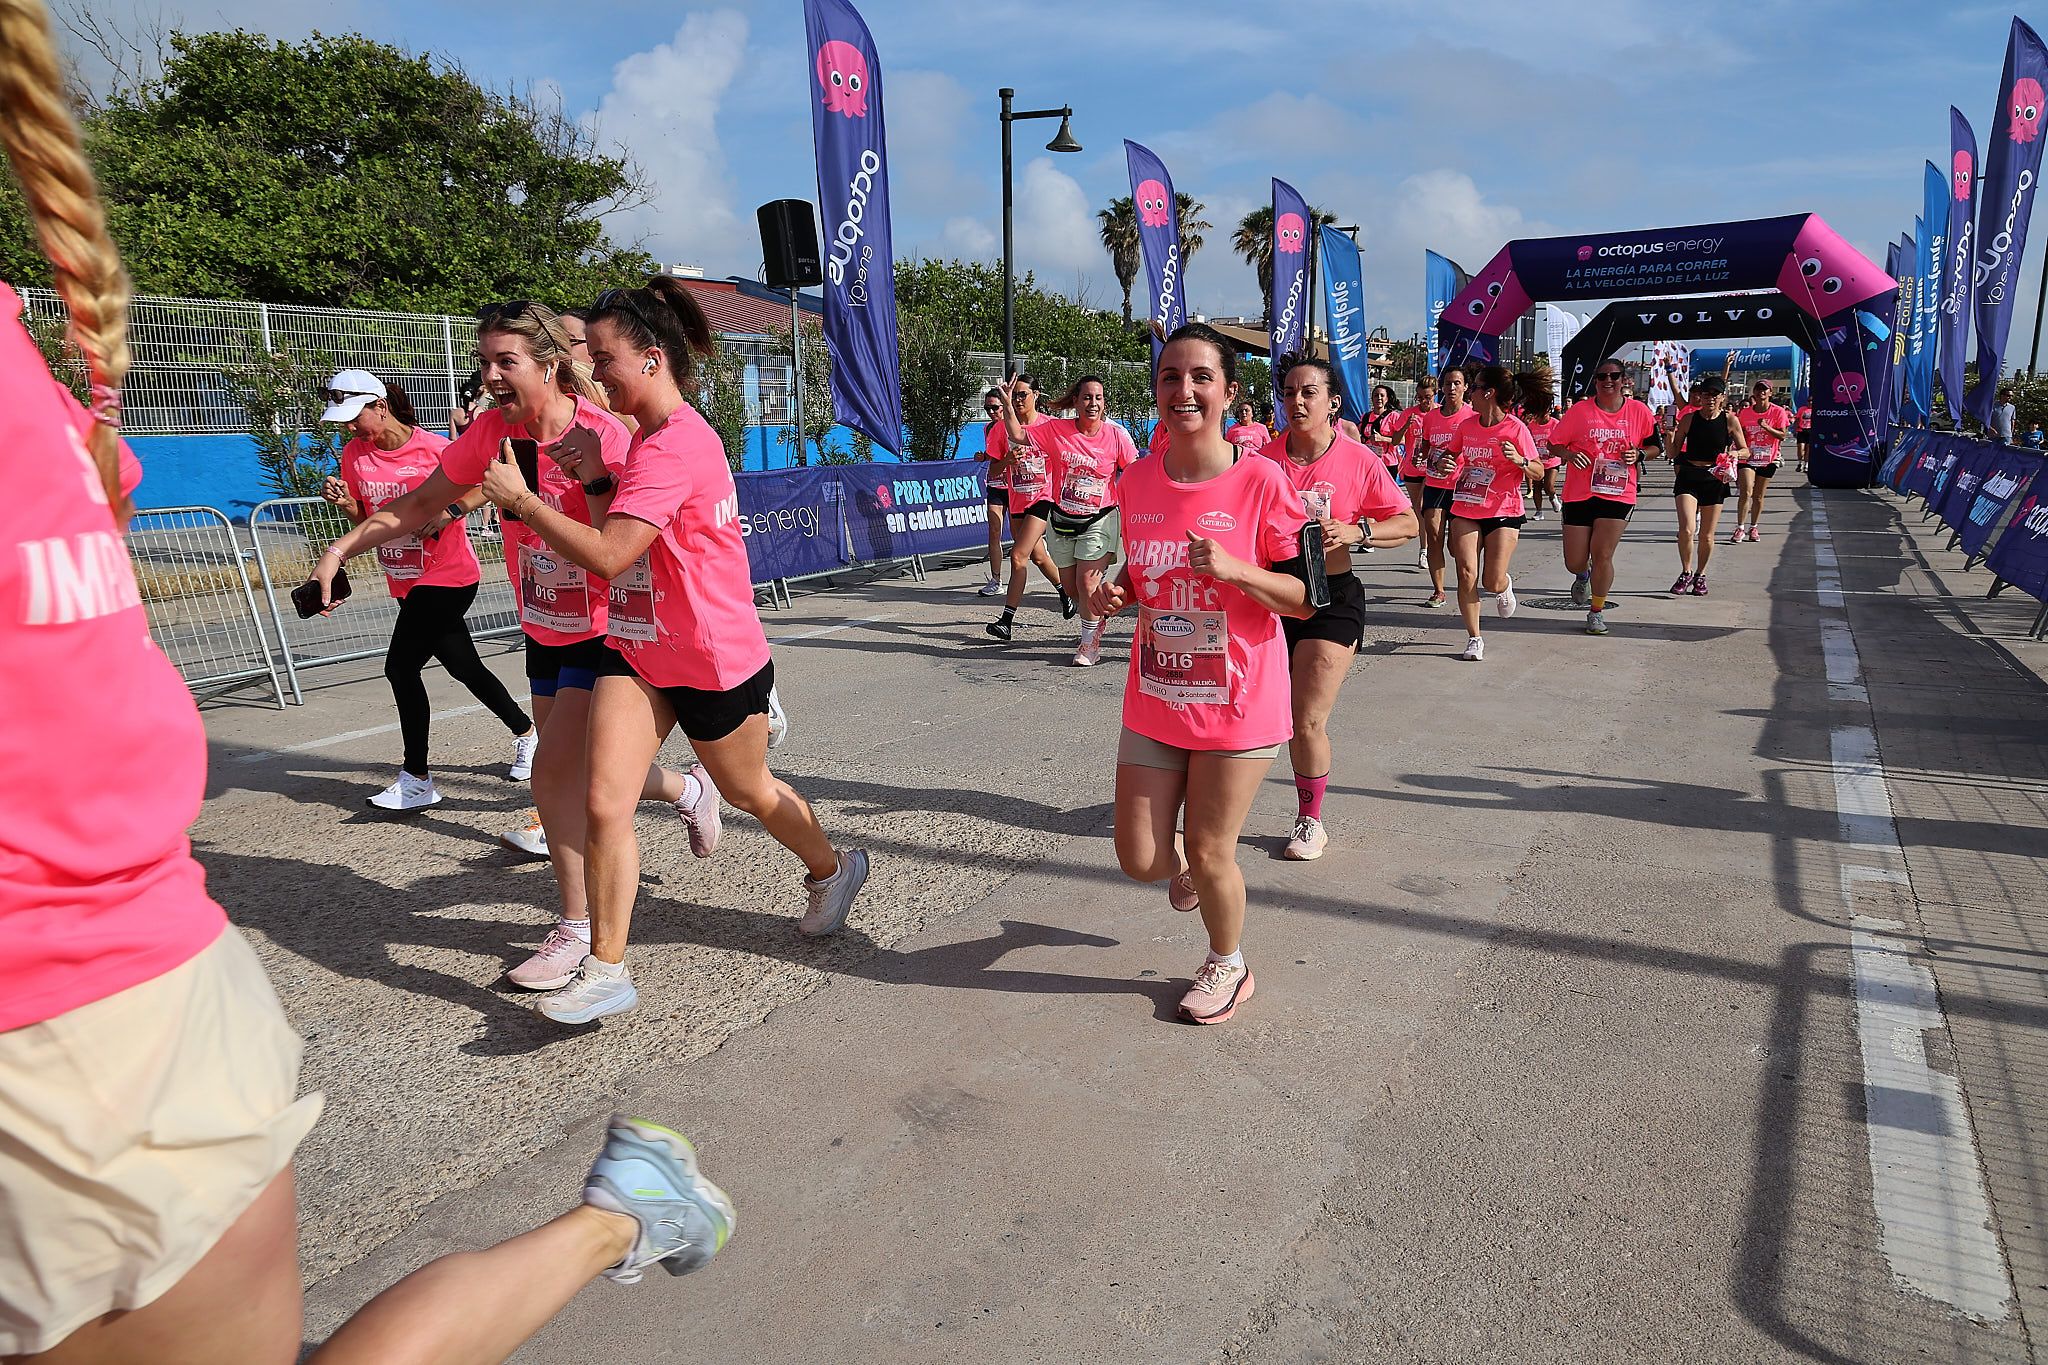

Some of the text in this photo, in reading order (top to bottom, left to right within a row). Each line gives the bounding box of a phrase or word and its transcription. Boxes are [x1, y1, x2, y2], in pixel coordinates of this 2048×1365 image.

[1598, 237, 1724, 258] octopus energy
[1566, 259, 1728, 278] LA ENERGÍA PARA CORRER
[1565, 271, 1730, 289] A LA VELOCIDAD DE LA LUZ
[1637, 307, 1774, 325] VOLVO
[1726, 349, 1771, 368] Marlene
[1816, 408, 1879, 418] octopus energy
[1589, 428, 1626, 439] CARRERA
[1061, 450, 1099, 469] CARRERA
[892, 475, 982, 506] PURA CHISPA
[1074, 490, 1090, 500] 016
[753, 505, 819, 538] energy
[885, 513, 907, 534] en
[908, 504, 944, 532] cada
[1130, 513, 1164, 524] OYSHO
[1200, 517, 1233, 528] ASTURIANA
[382, 547, 404, 559] 016
[1127, 540, 1190, 568] CARRE
[535, 584, 557, 602] 016
[609, 586, 628, 604] 016
[1171, 577, 1201, 611] DE
[1155, 621, 1192, 633] ASTURIANA
[1156, 652, 1193, 669] 016
